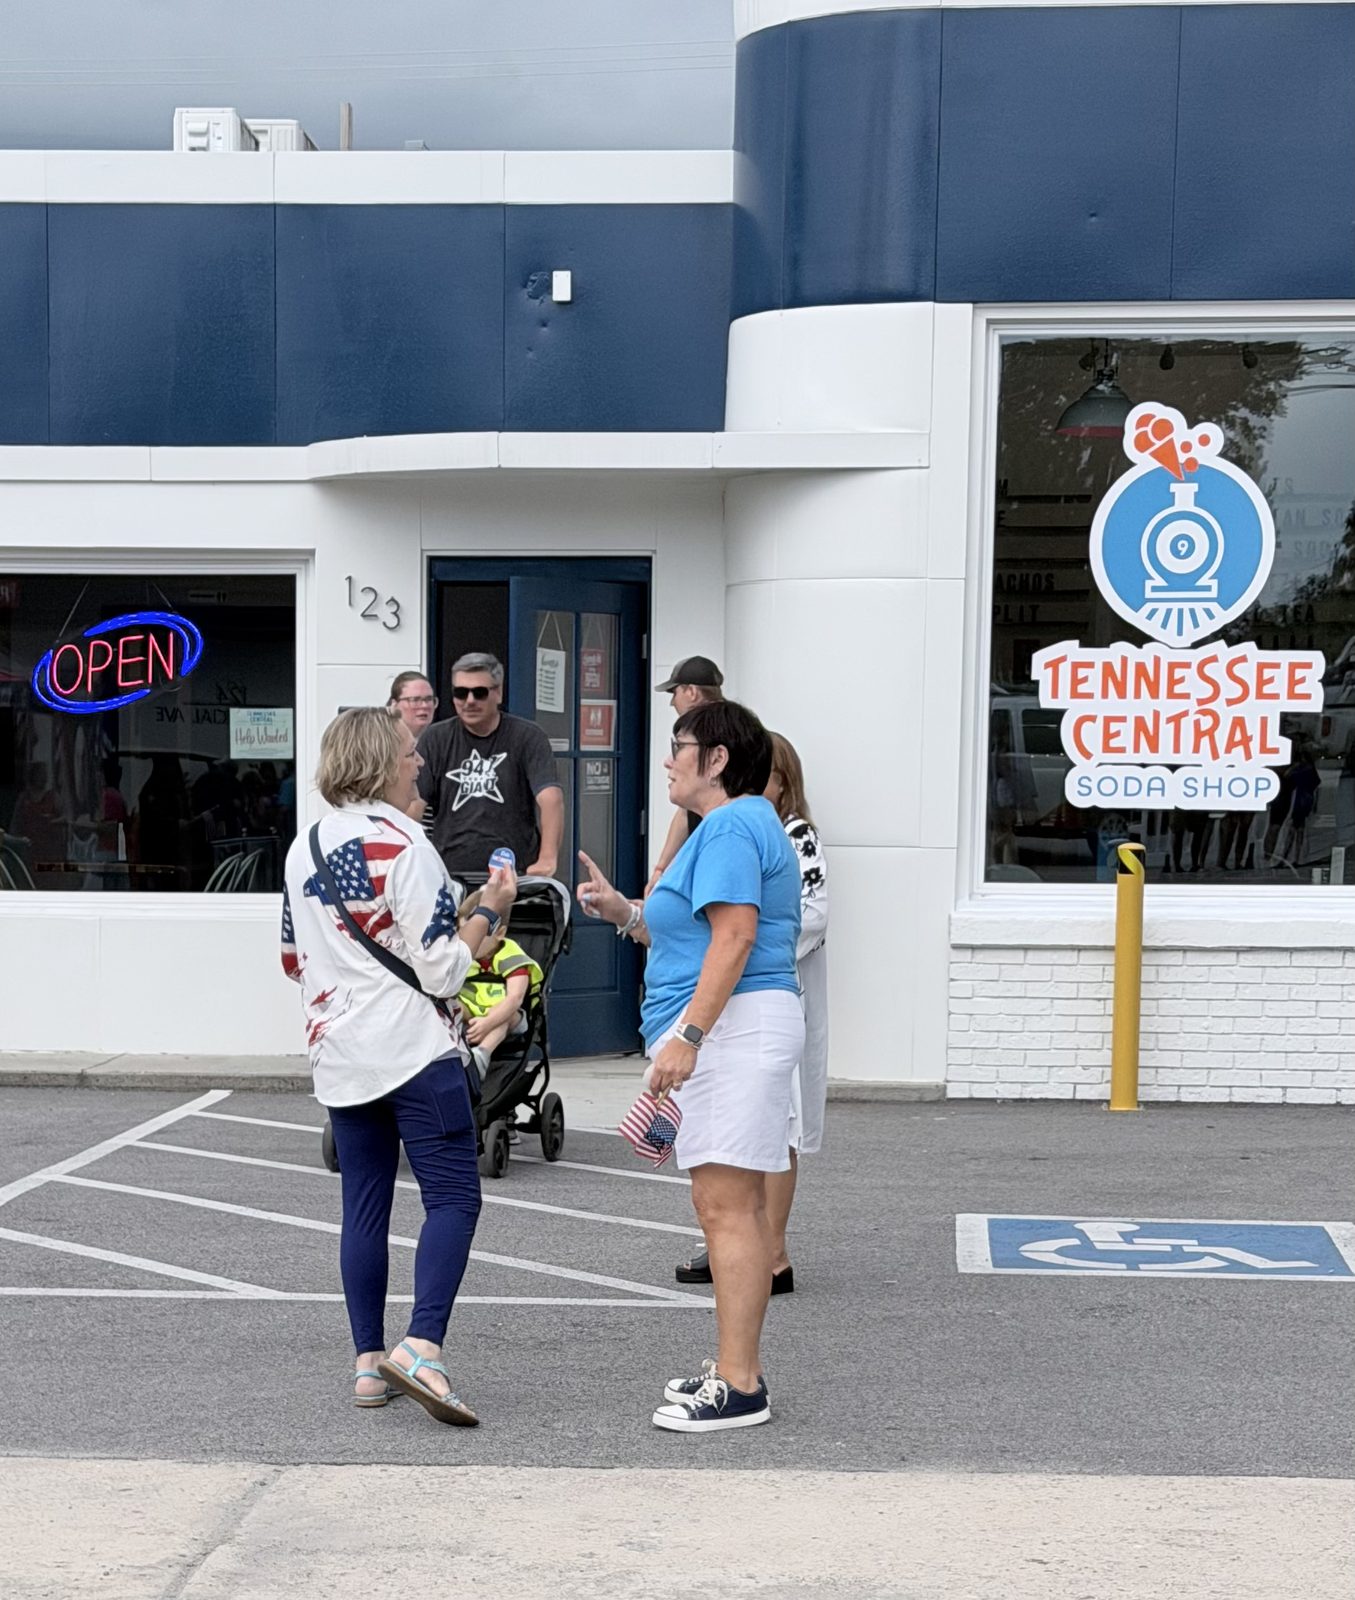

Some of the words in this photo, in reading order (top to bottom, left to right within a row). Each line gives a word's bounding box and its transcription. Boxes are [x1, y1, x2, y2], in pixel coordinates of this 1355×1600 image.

[1177, 539, 1190, 555] 9
[996, 572, 1055, 593] ACHOS
[344, 575, 402, 631] 123
[993, 605, 1041, 625] PLIT
[51, 631, 174, 695] OPEN
[1042, 654, 1314, 707] TENNESSEE
[1072, 708, 1280, 761] CENTRAL
[1076, 775, 1166, 798] SODA
[1182, 775, 1272, 798] SHOP
